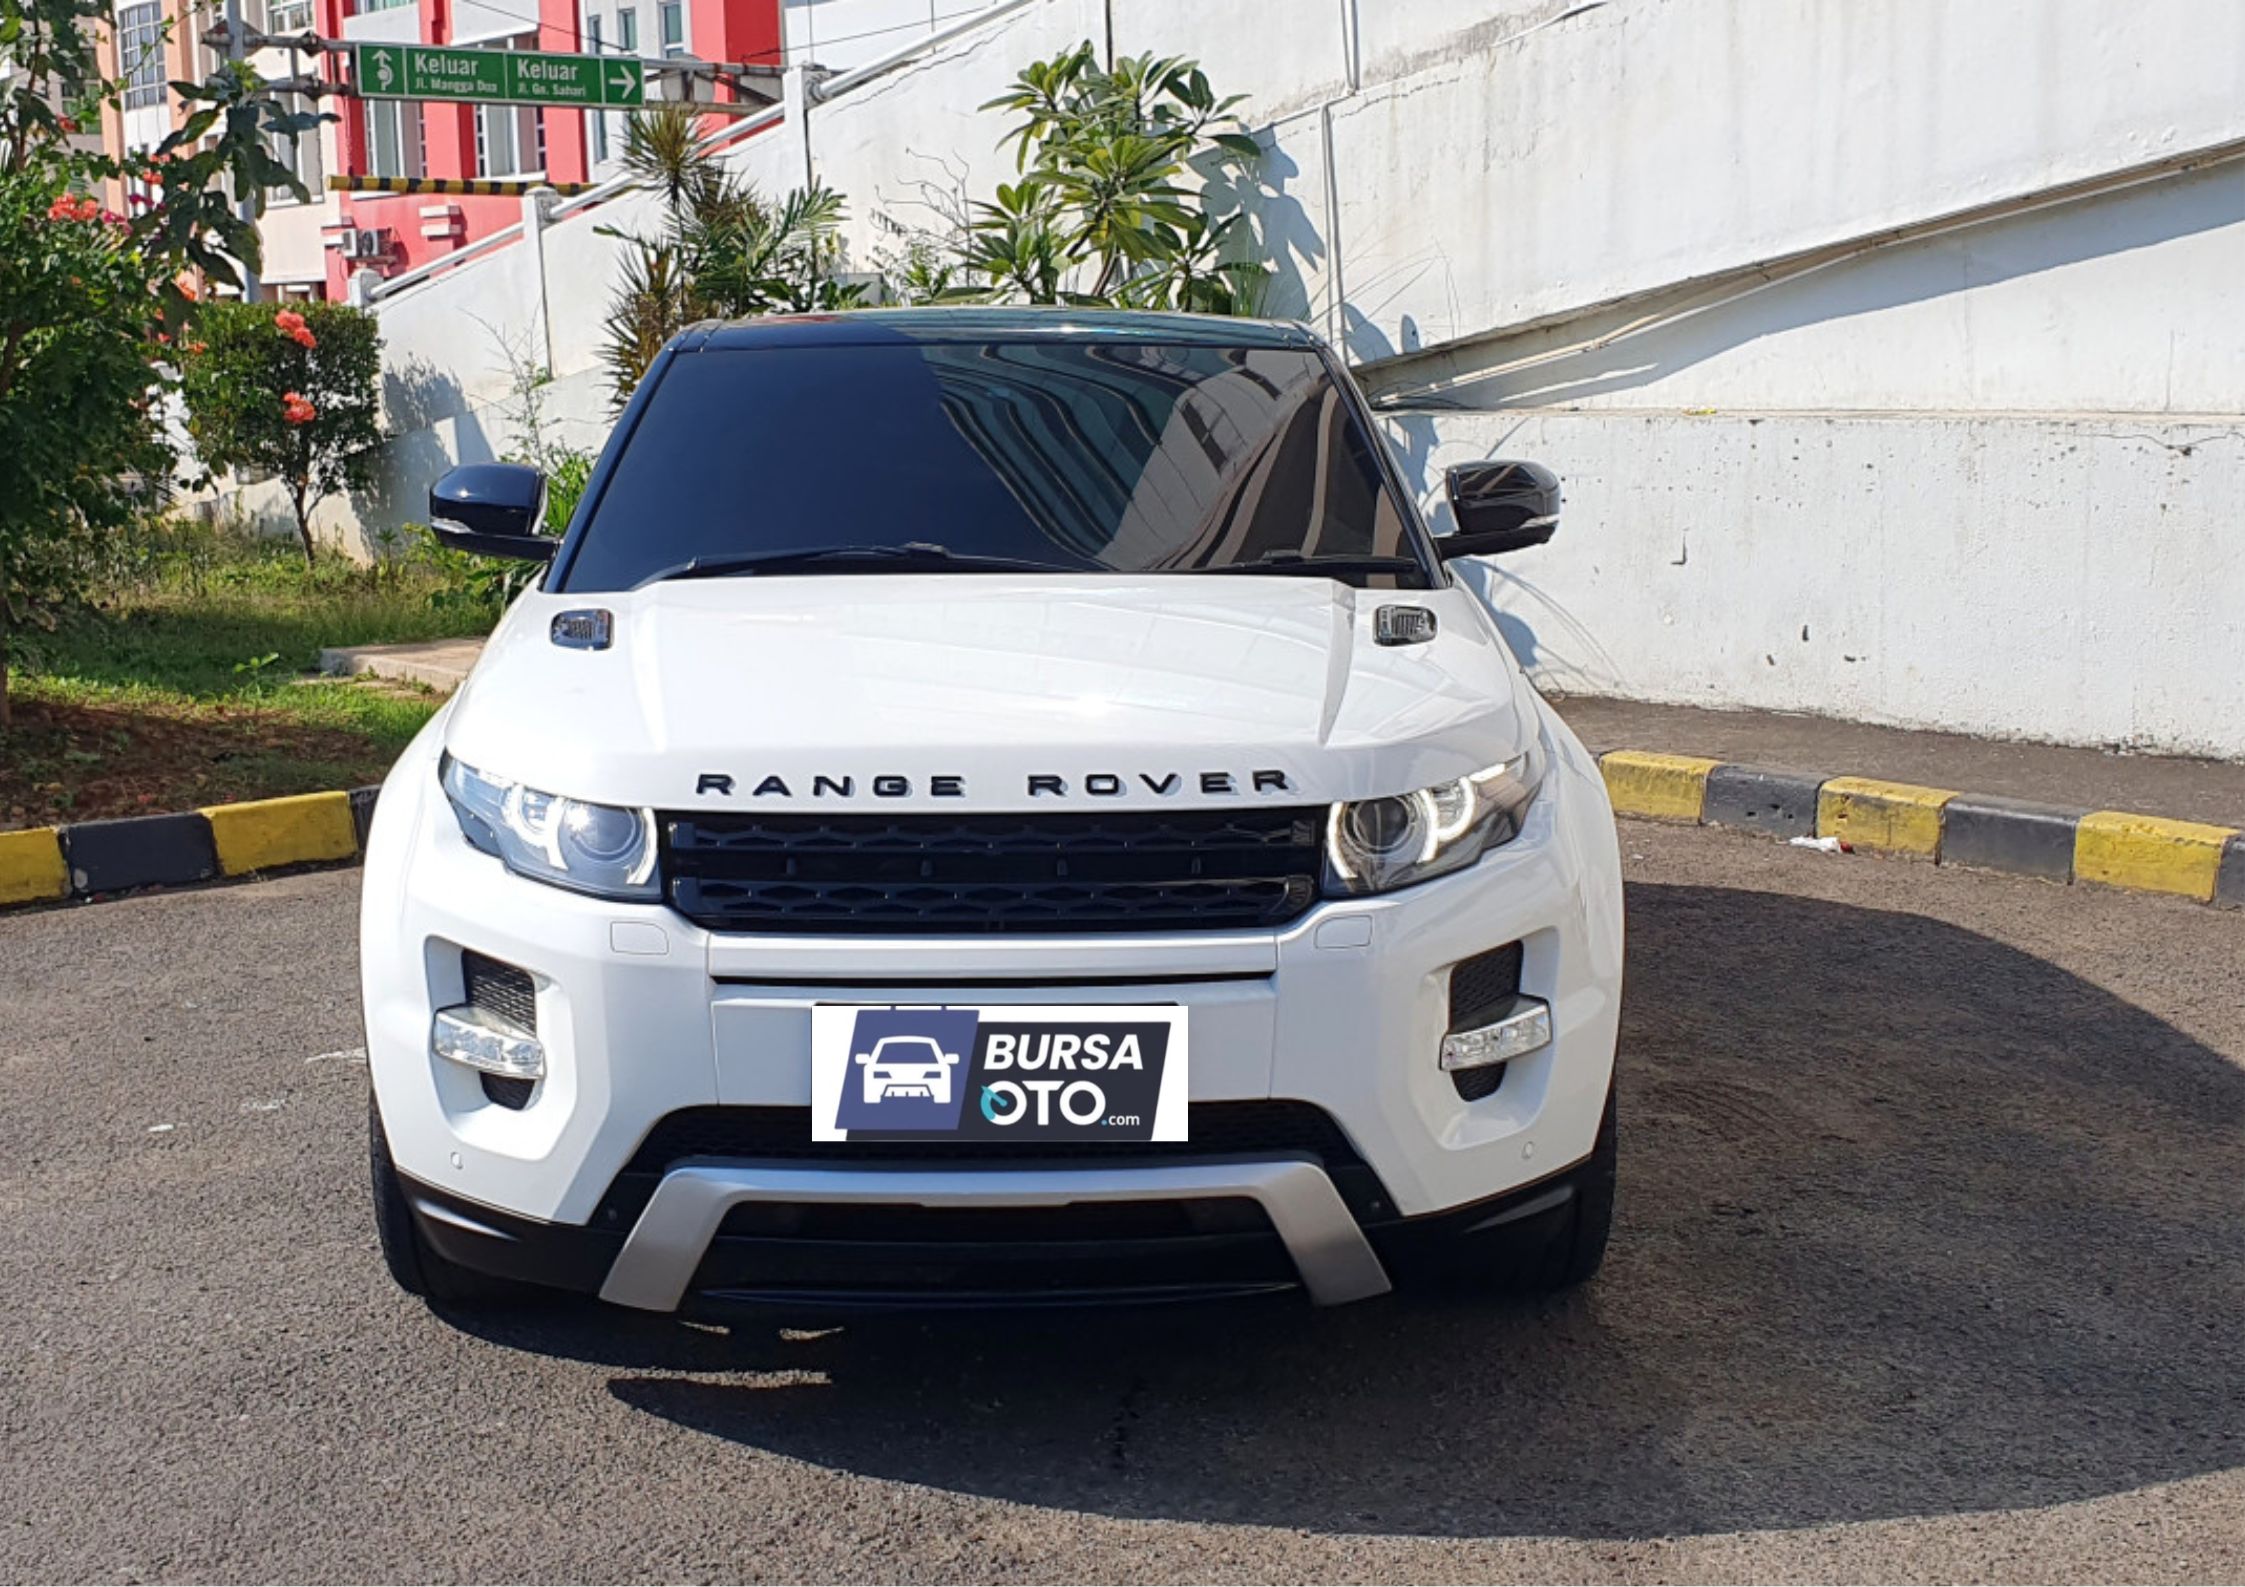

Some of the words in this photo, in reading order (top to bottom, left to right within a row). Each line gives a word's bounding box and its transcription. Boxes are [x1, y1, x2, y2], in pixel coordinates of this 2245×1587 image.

[414, 53, 478, 76] Keluar
[517, 58, 578, 80] Keluar
[431, 79, 474, 93] Mangga
[696, 774, 966, 797] RANGE
[1027, 770, 1290, 796] ROVER
